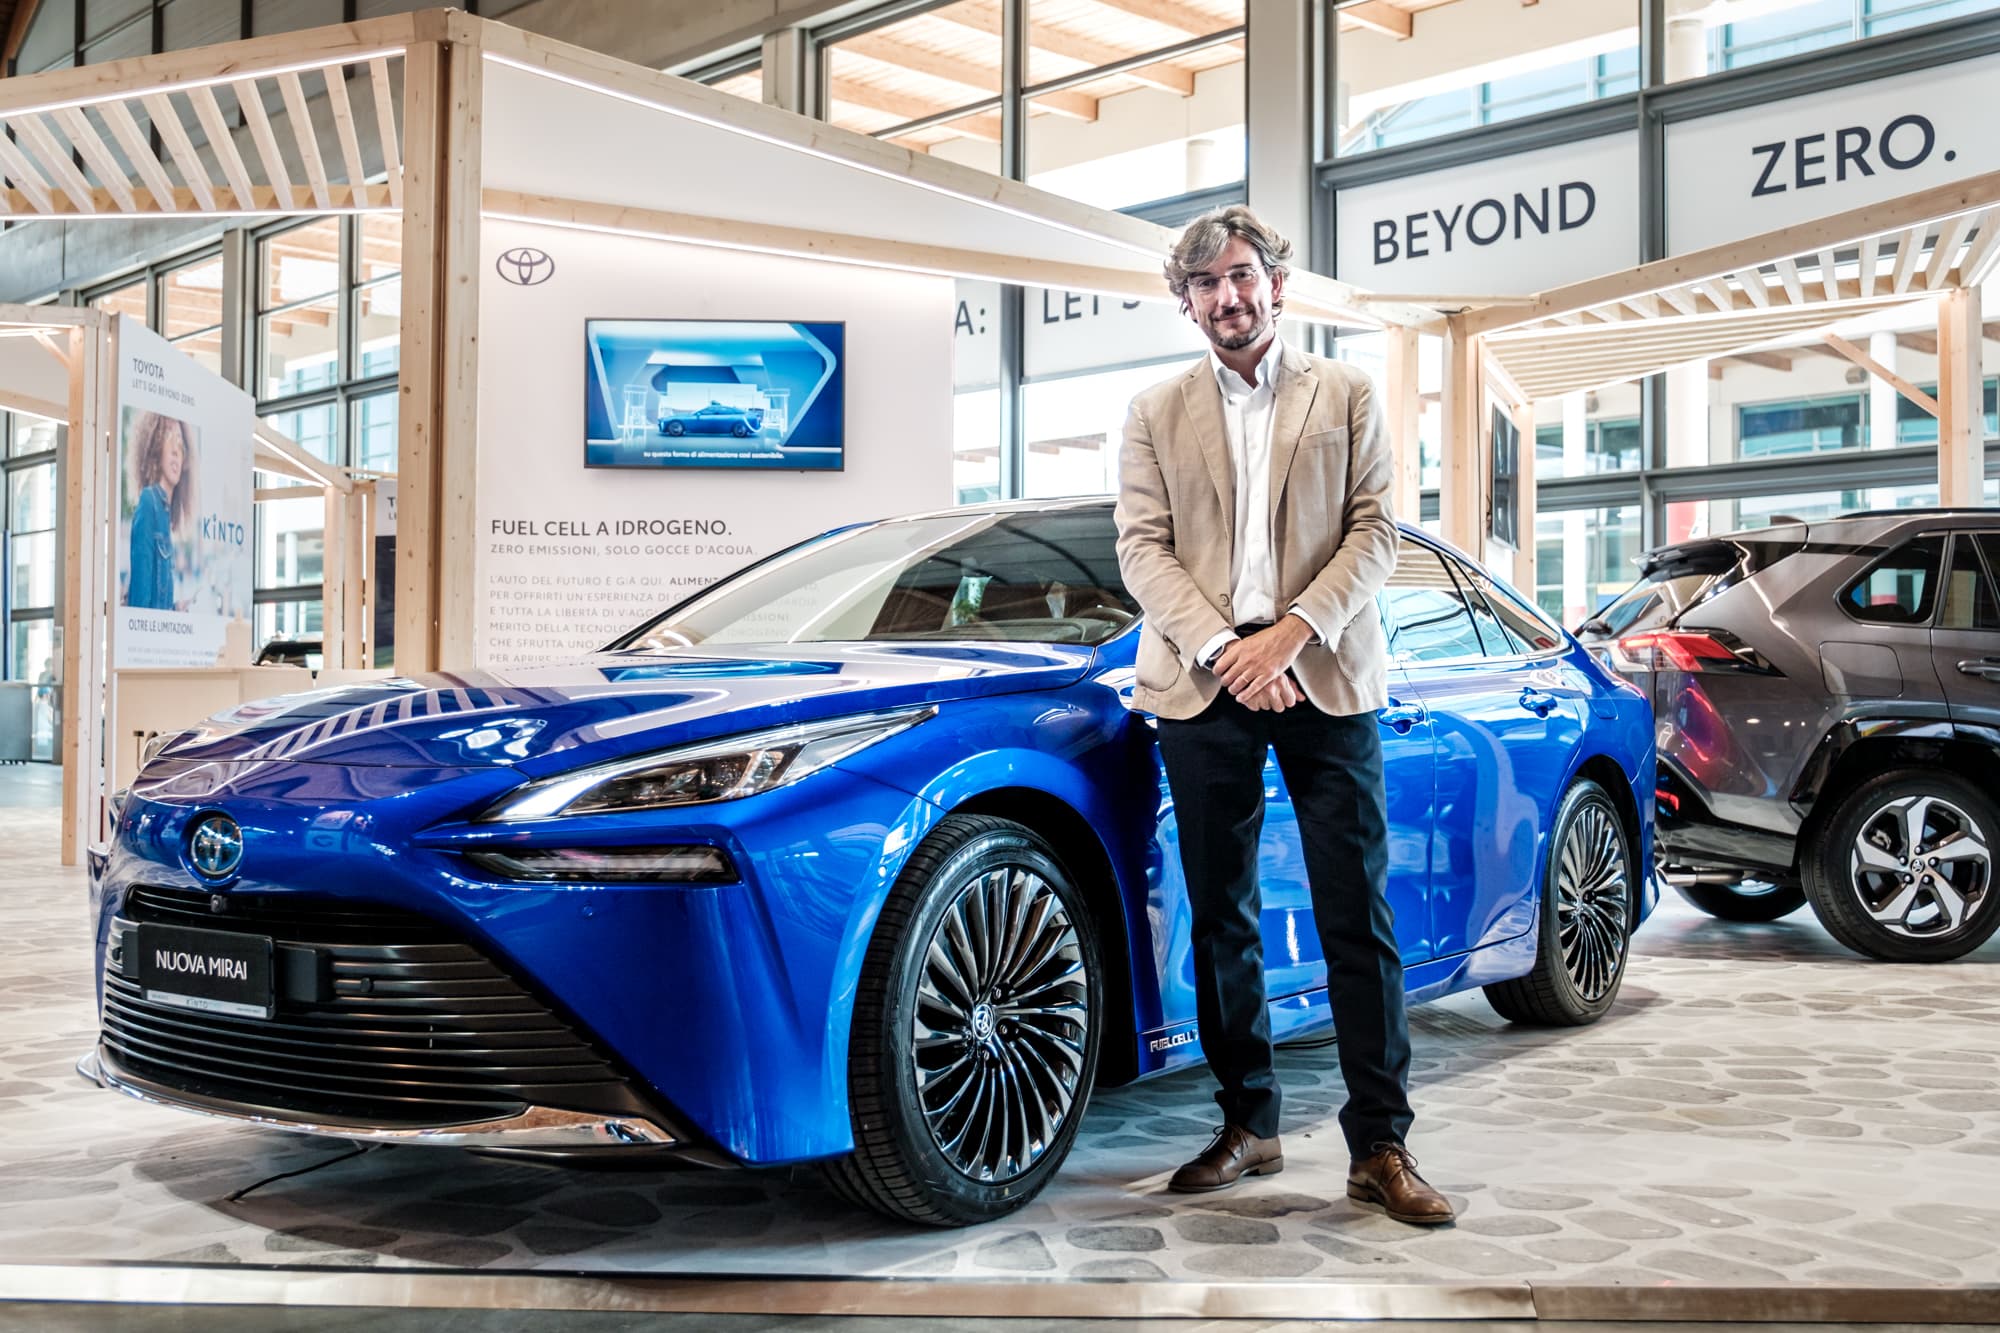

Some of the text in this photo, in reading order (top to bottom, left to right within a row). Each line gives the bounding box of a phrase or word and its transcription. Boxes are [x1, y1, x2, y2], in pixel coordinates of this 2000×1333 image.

[1751, 114, 1957, 198] ZERO.
[1373, 181, 1597, 266] BEYOND
[132, 358, 164, 381] TOYOTA
[491, 519, 733, 537] FUEL CELL A IDROGENO.
[490, 543, 758, 557] ZERO EMISSIONI, SOLO GOCCE D'ACQUA.
[489, 575, 528, 585] L'AUTO
[531, 575, 553, 585] DEL
[556, 576, 602, 586] FUTURO
[489, 591, 510, 601] PER
[513, 592, 563, 601] OFFRIRTI
[500, 607, 534, 617] TUTTA
[537, 608, 552, 617] LA
[602, 608, 615, 617] DI
[128, 618, 148, 632] OLTRE
[149, 620, 157, 632] LE
[489, 622, 532, 632] MERITO
[535, 623, 570, 633] DELLA
[489, 638, 512, 647] CHE
[515, 639, 564, 649] SFRUTTA
[567, 640, 594, 649] UNO
[489, 654, 509, 662] PER
[156, 949, 247, 981] NUOVA MIRAI
